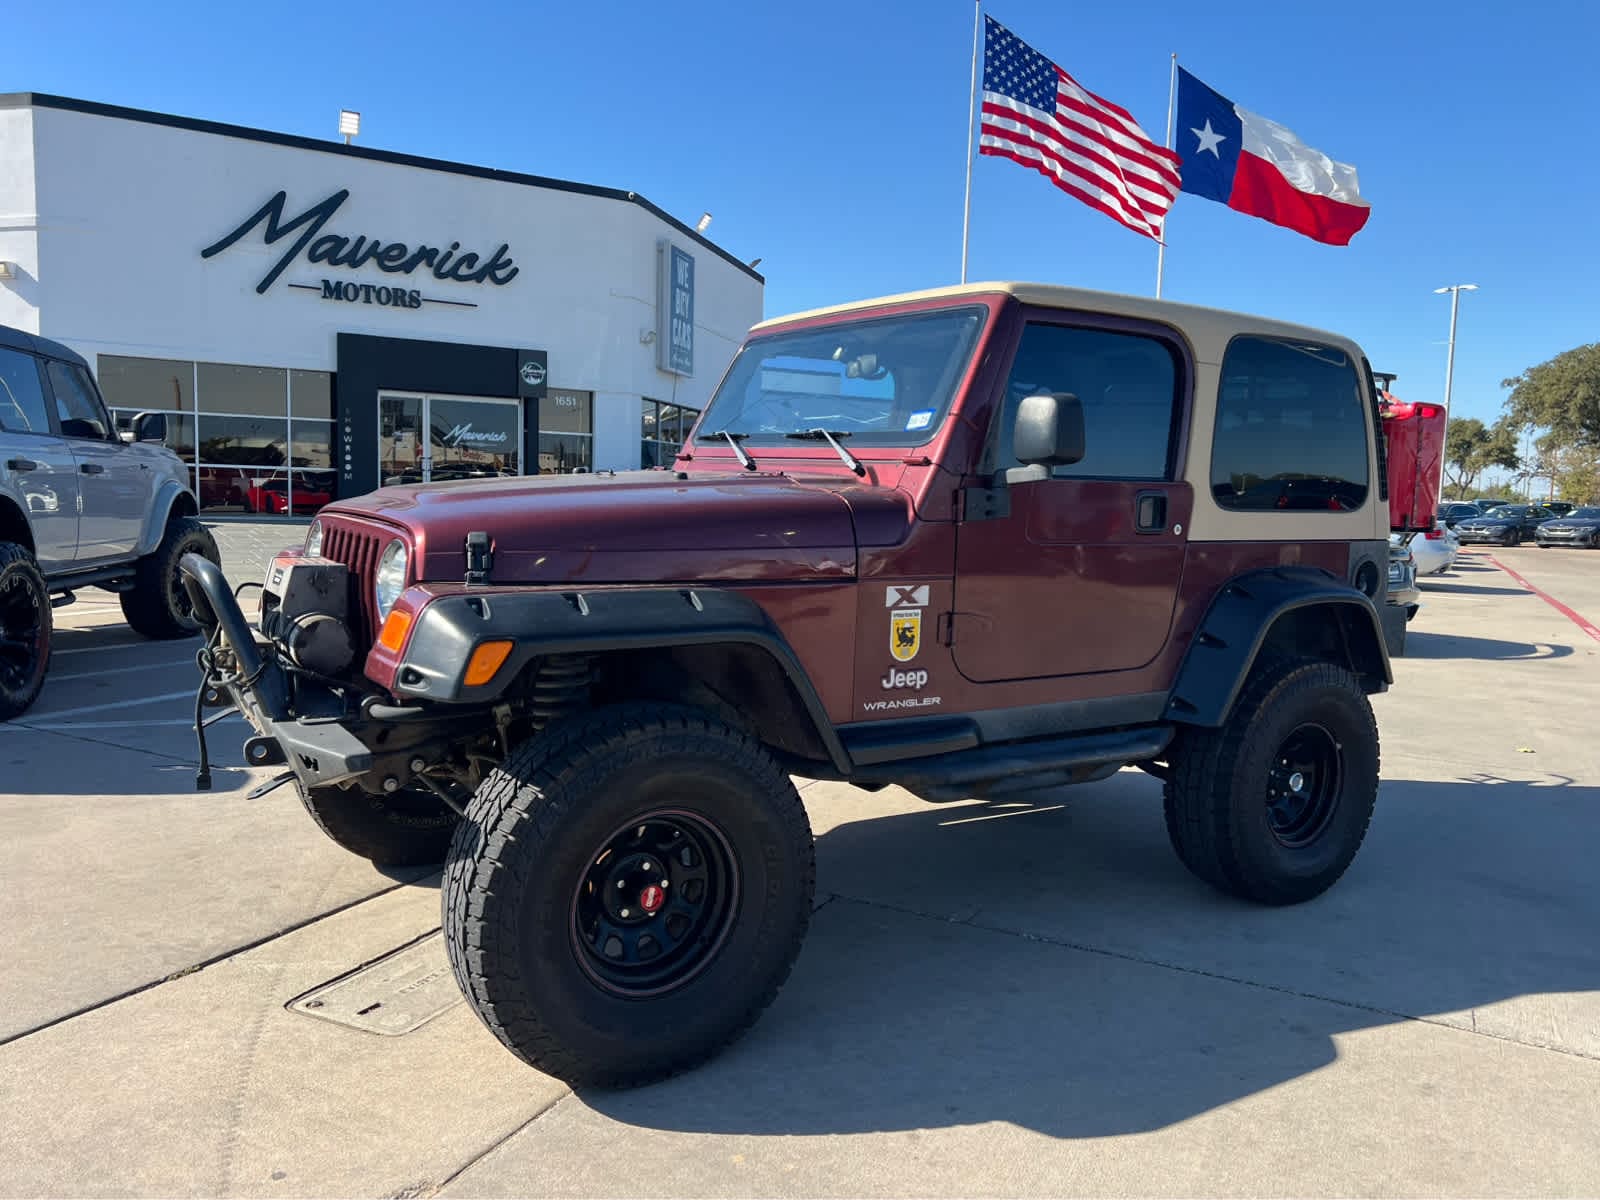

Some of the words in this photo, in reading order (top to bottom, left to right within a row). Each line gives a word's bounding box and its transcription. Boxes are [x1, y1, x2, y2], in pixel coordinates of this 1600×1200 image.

[201, 188, 519, 295] Maverick
[321, 279, 422, 309] MOTORS
[554, 395, 577, 407] 1651
[881, 668, 928, 689] Jeep
[863, 696, 942, 711] WRANGLER
